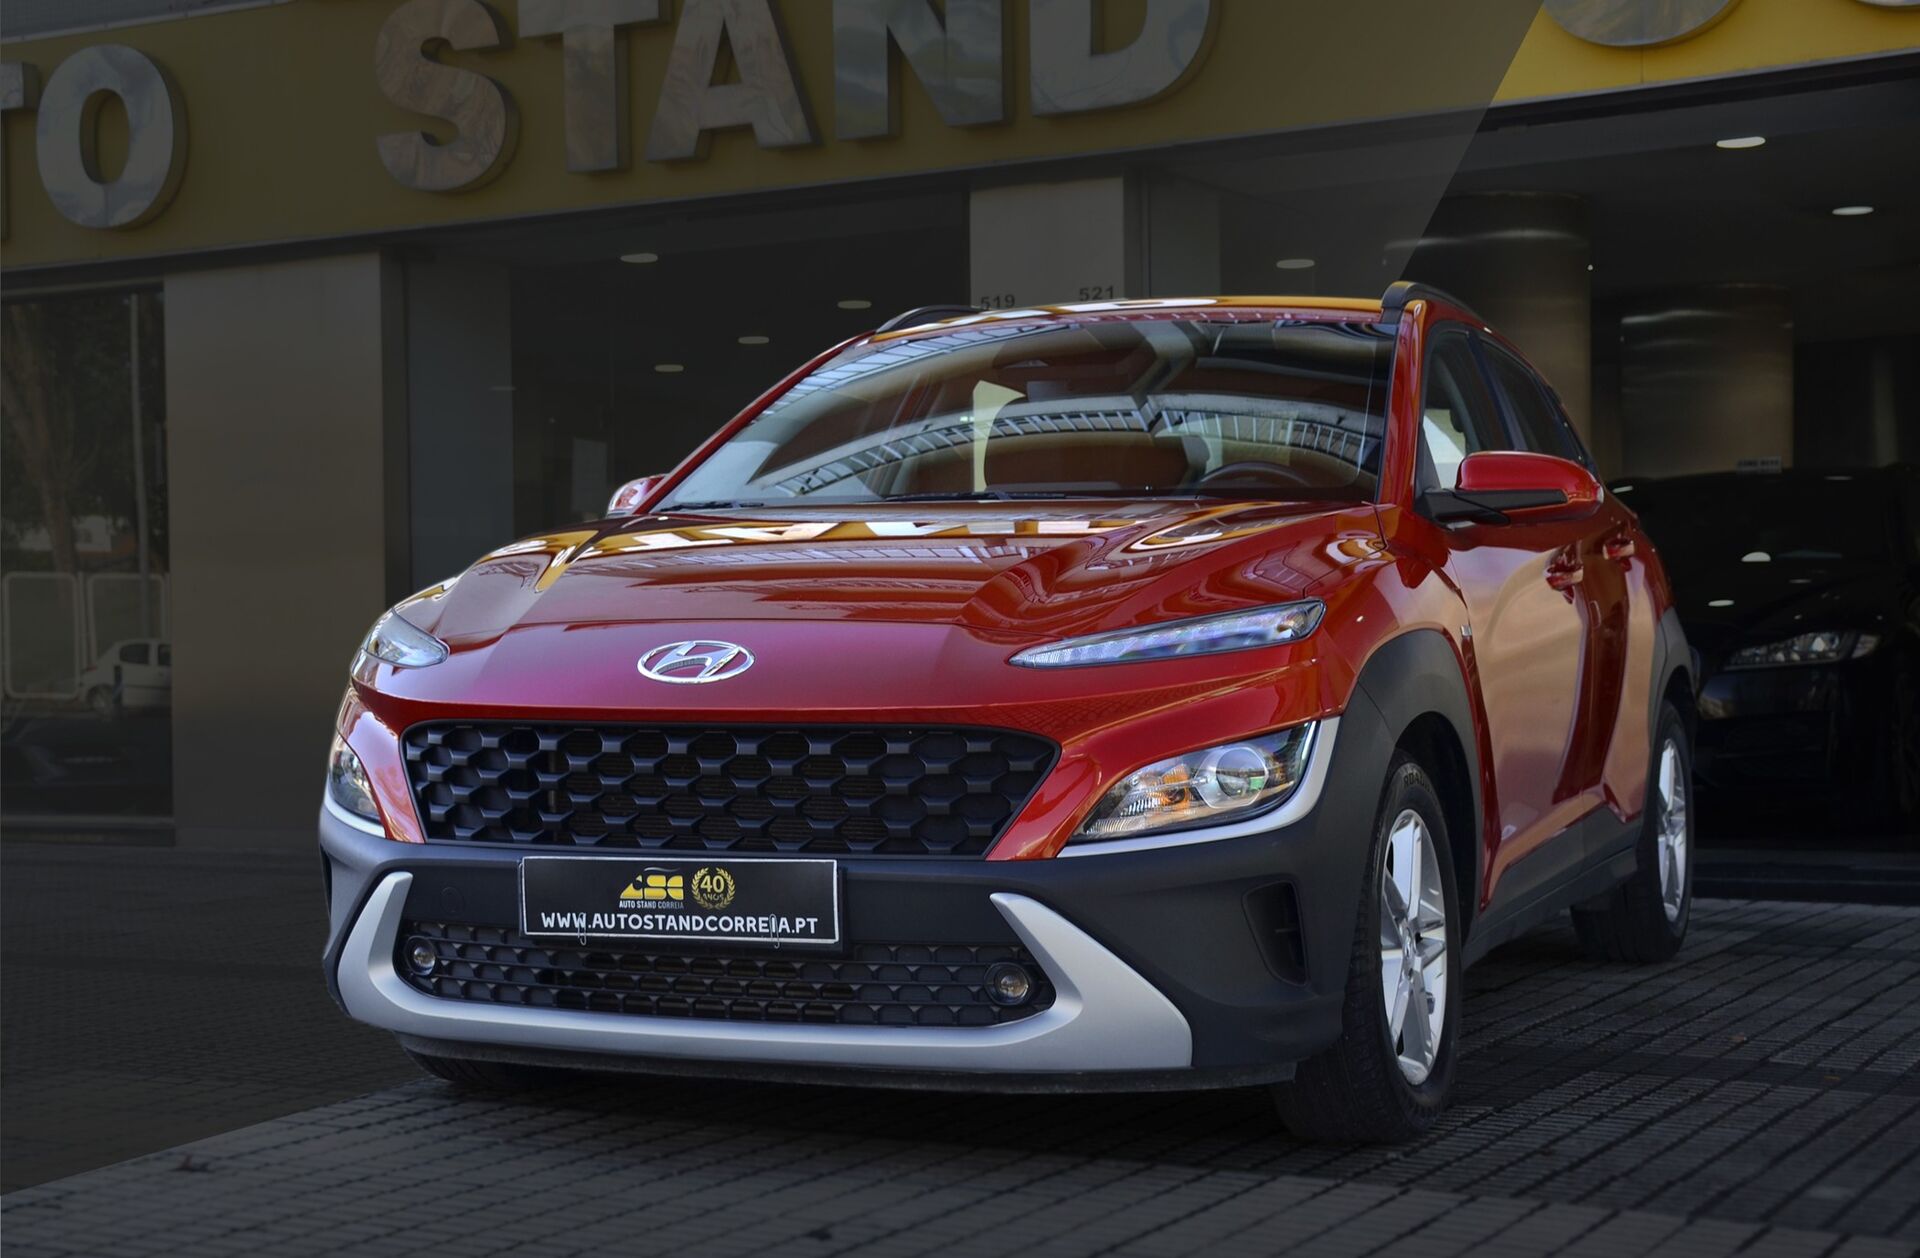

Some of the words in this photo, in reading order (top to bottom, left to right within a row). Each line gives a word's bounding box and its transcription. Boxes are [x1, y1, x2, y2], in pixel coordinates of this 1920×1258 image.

[374, 0, 1219, 193] STAND
[1079, 286, 1115, 301] 521
[981, 294, 1015, 311] 519
[700, 875, 725, 893] 40
[619, 900, 636, 909] AUTO
[637, 901, 657, 909] STAND
[658, 901, 685, 910] CORREIA
[541, 911, 819, 935] WWW.AUTOSTANDCORREIA.PT
